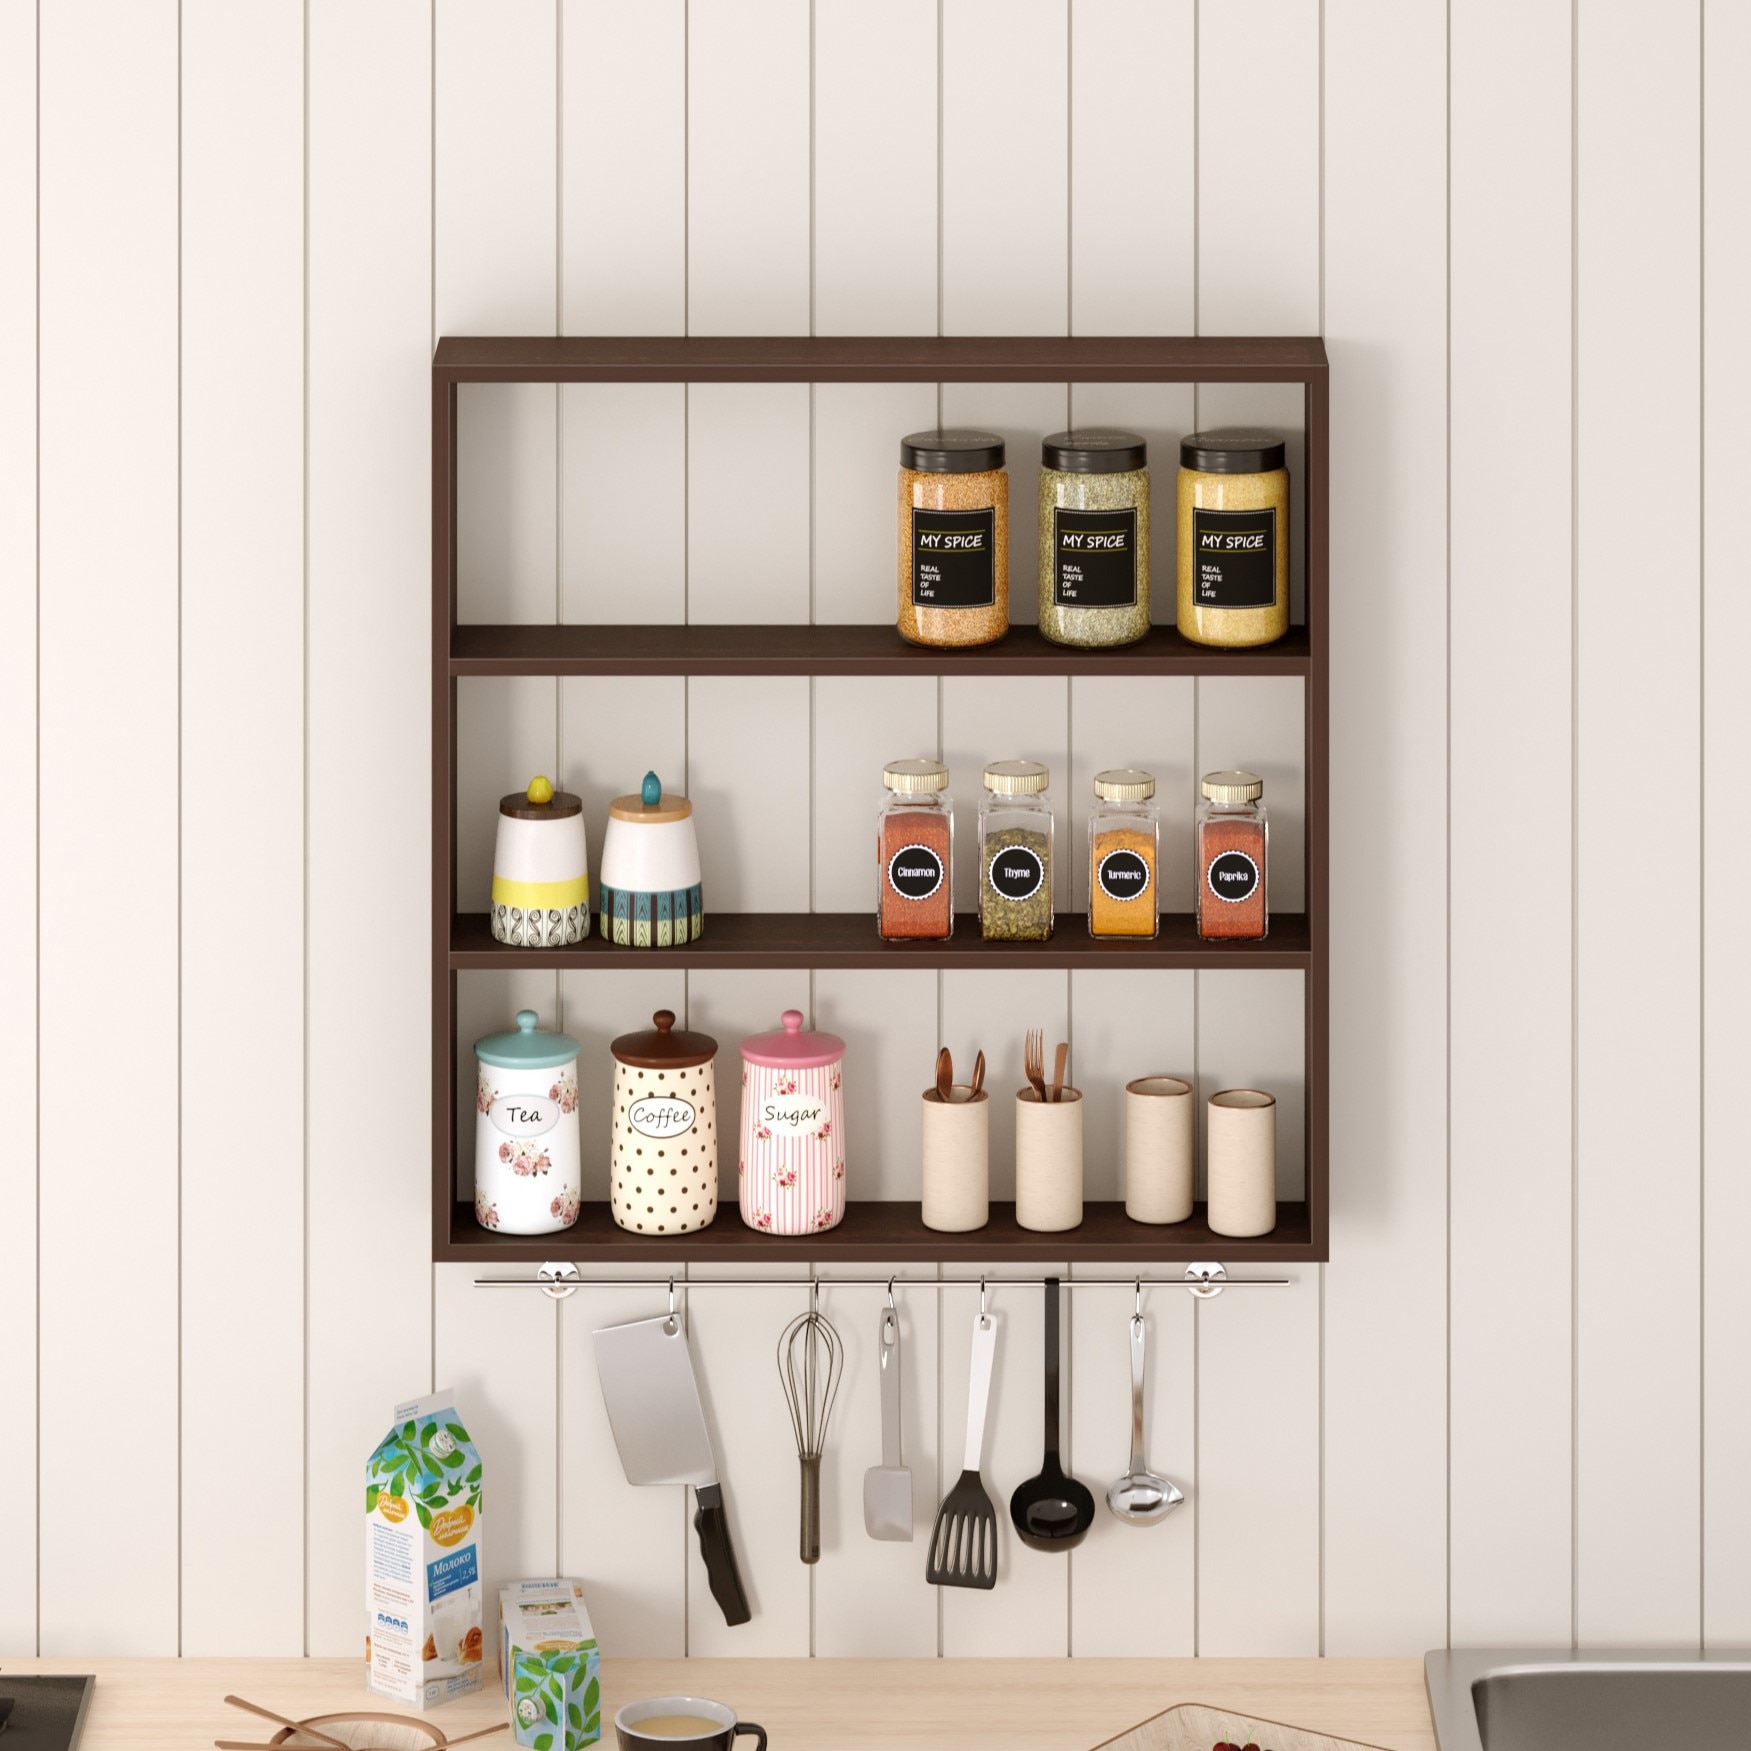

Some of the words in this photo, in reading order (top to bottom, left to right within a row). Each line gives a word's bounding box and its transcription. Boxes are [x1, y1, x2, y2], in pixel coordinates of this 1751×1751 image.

[920, 534, 942, 548] MY
[944, 534, 983, 549] SPICE
[1062, 534, 1084, 548] MY
[1086, 534, 1125, 549] SPICE
[1201, 534, 1223, 548] MY
[1225, 534, 1264, 549] SPICE
[920, 564, 940, 573] REAL
[1062, 564, 1082, 573] REAL
[1201, 564, 1221, 573] REAL
[920, 573, 942, 582] TASTE
[1062, 573, 1084, 582] TASTE
[1201, 573, 1223, 582] TASTE
[920, 581, 930, 589] OF
[1062, 581, 1072, 589] OF
[1201, 581, 1211, 589] OF
[920, 589, 935, 598] LIFE
[1062, 589, 1077, 598] LIFE
[1201, 589, 1216, 598] LIFE
[897, 866, 936, 878] Cinnamon
[1003, 867, 1031, 880] Thyme
[1107, 869, 1142, 880] Turmeric
[1219, 871, 1249, 882] Paprika
[506, 1107, 543, 1123] Tea
[634, 1106, 691, 1129] Coffee
[765, 1105, 821, 1127] Sugar
[433, 1552, 471, 1577] Молоко
